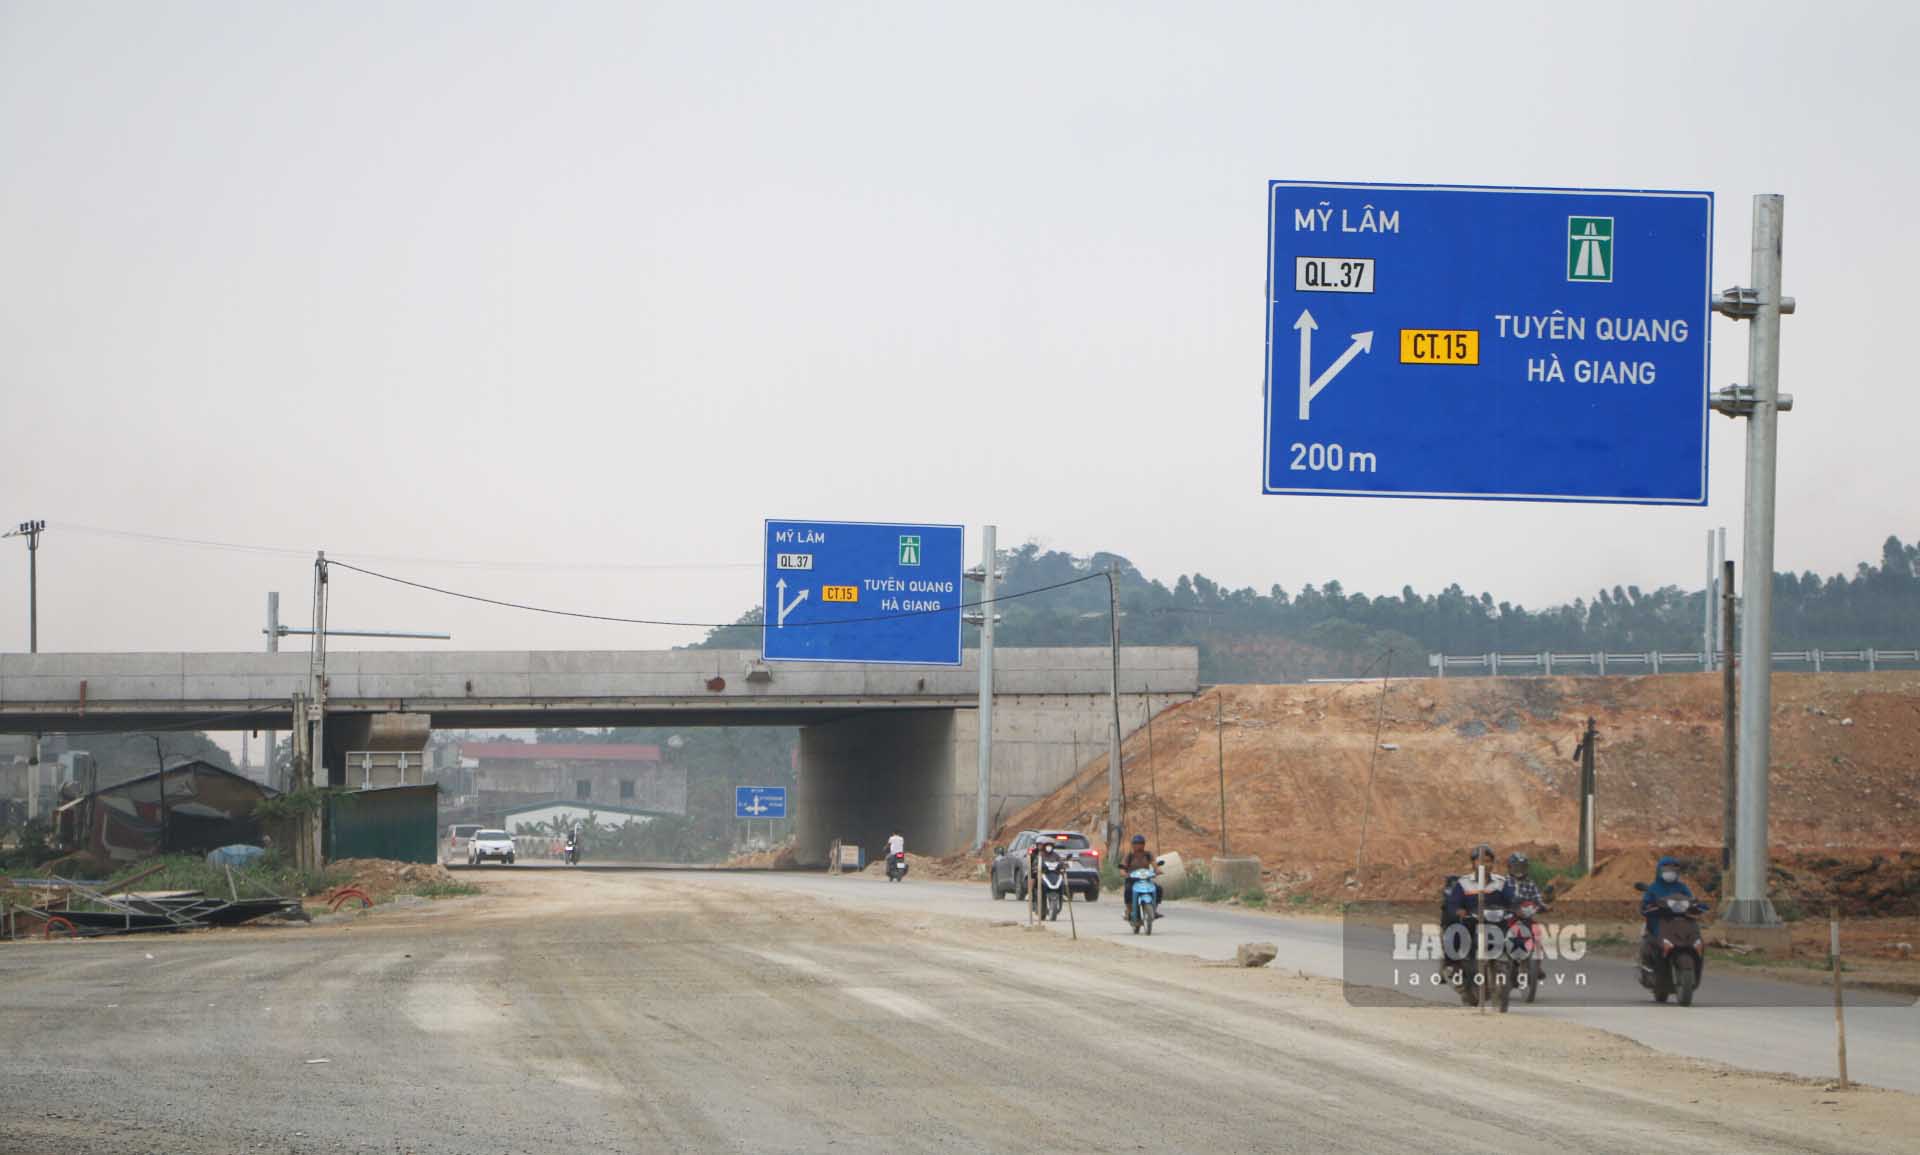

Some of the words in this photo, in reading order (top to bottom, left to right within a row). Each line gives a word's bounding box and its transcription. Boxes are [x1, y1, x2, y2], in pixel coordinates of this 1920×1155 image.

[1295, 201, 1333, 232] MỸ
[1342, 204, 1400, 233] LÂM
[1305, 261, 1365, 288] QL.37
[1495, 309, 1585, 340] TUYÊN
[1596, 317, 1689, 343] QUANG
[1413, 333, 1467, 360] CT.15
[1527, 353, 1565, 383] HÀ
[1574, 360, 1656, 385] GIANG
[798, 529, 825, 544] LÂM
[780, 555, 808, 568] QL.37
[827, 587, 853, 600] CT.15
[864, 576, 905, 592] TUYÊN
[909, 580, 953, 593] QUANG
[881, 596, 899, 611] HÀ
[903, 600, 941, 612] GIANG
